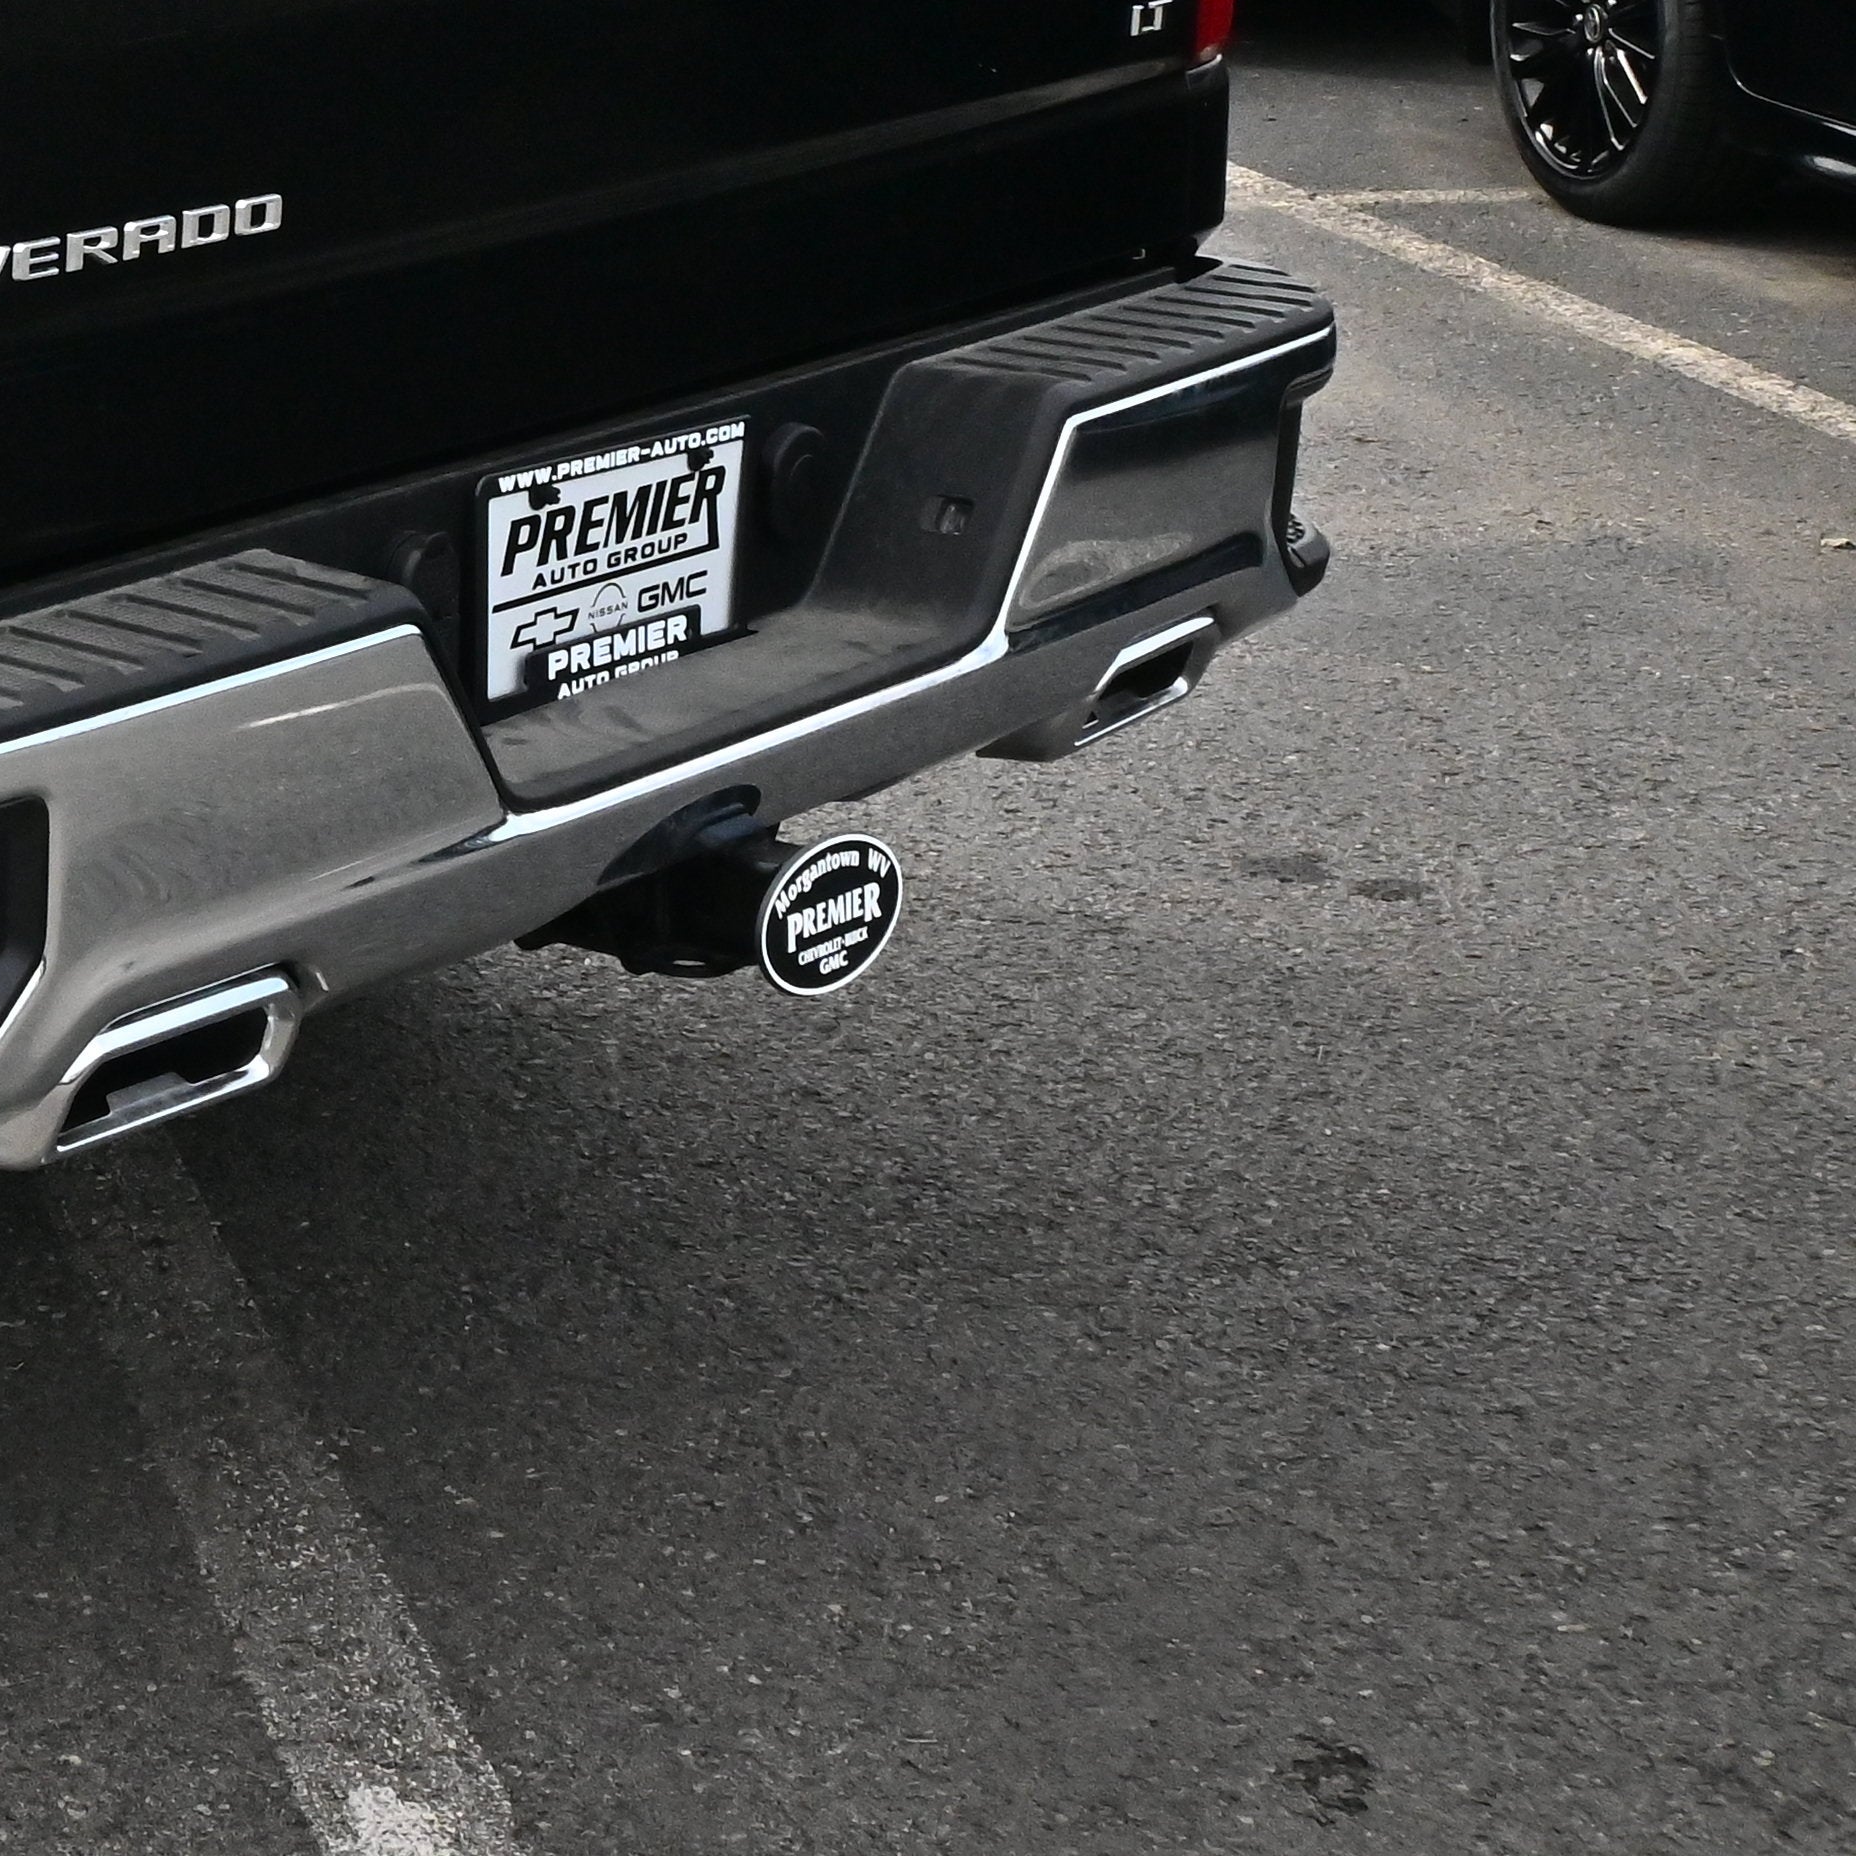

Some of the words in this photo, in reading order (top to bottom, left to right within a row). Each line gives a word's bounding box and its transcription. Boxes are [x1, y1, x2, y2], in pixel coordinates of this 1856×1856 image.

[498, 421, 745, 493] WWW.PREMIER-AUTO.COM
[500, 465, 726, 578] PREMIER
[532, 557, 598, 591] AUTO
[606, 532, 688, 569] GROUP
[638, 570, 708, 613] GMC
[588, 601, 629, 619] NISSAN
[547, 614, 687, 681] PREMIER
[557, 670, 610, 700] AUTO
[774, 850, 860, 920] Morgantown
[867, 847, 892, 879] WV
[787, 882, 882, 953] PREMIER
[819, 950, 849, 975] GMC
